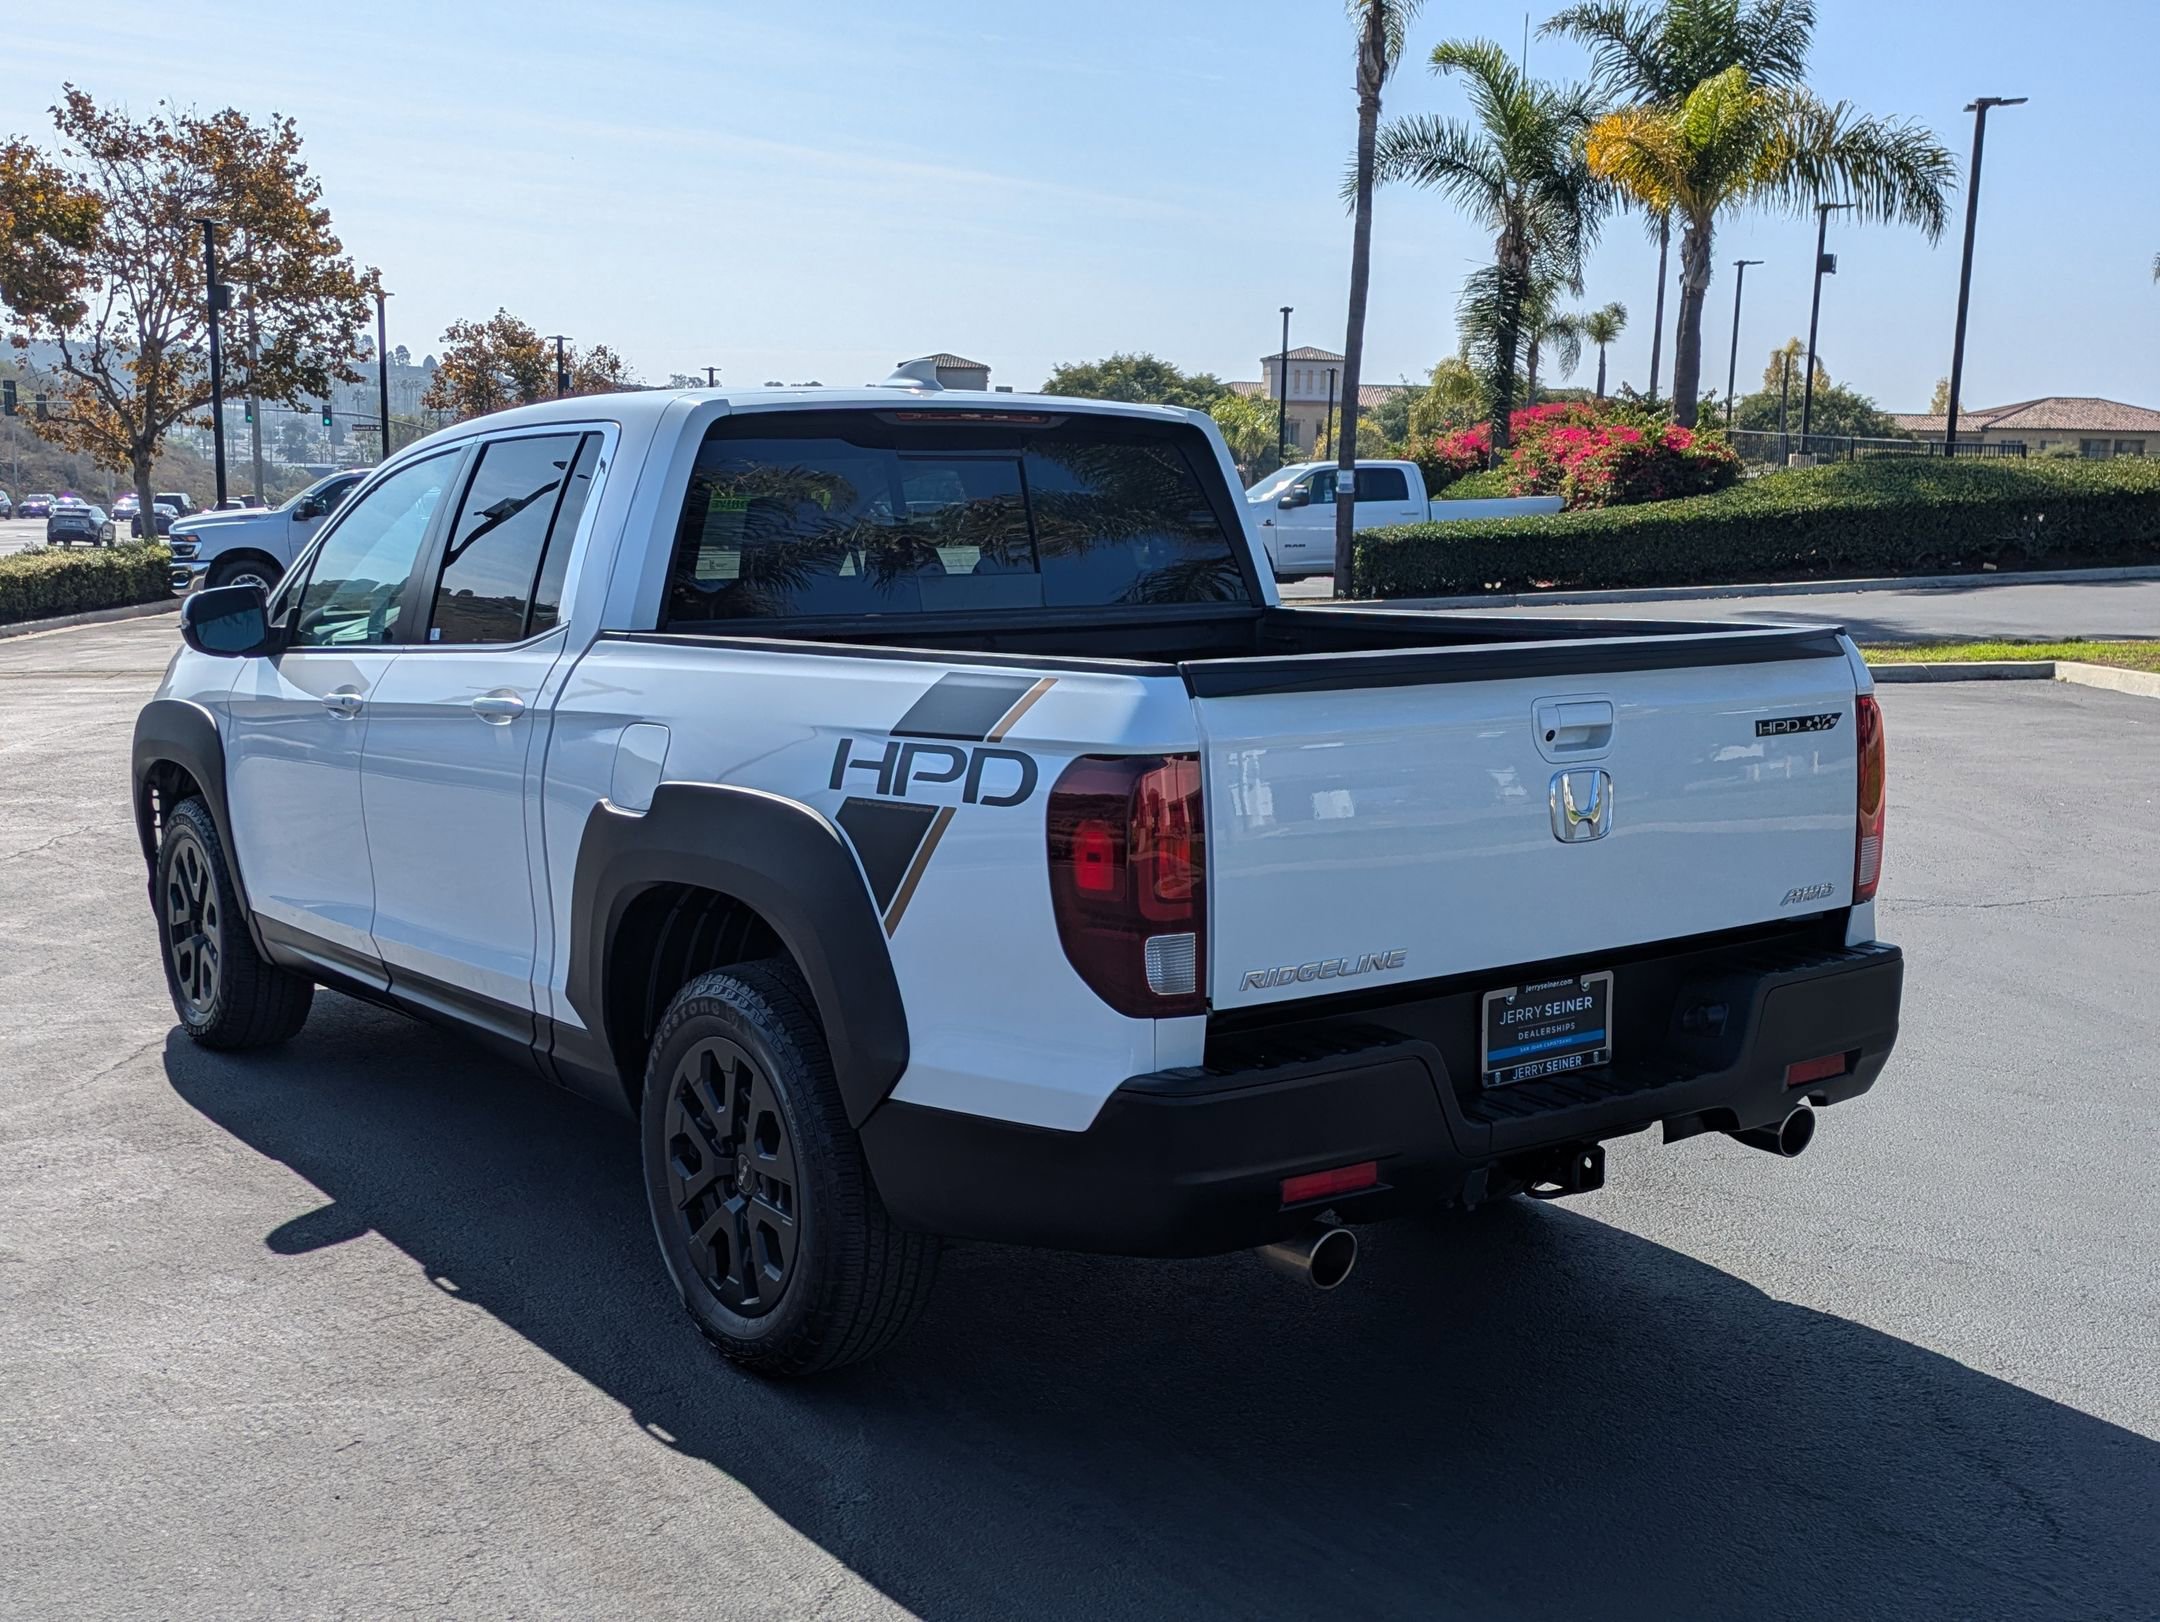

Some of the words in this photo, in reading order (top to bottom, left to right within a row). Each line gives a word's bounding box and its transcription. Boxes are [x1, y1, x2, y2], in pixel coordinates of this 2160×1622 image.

[1758, 719, 1800, 735] HPD
[828, 738, 1039, 808] HPD
[1239, 947, 1409, 992] RIDGELINE
[1499, 1005, 1543, 1025] JERRY
[1544, 996, 1593, 1016] SEINER
[1518, 1022, 1576, 1040] DEALERSHIPS
[1512, 1063, 1546, 1080] JERRY
[1546, 1055, 1582, 1073] SEINER
